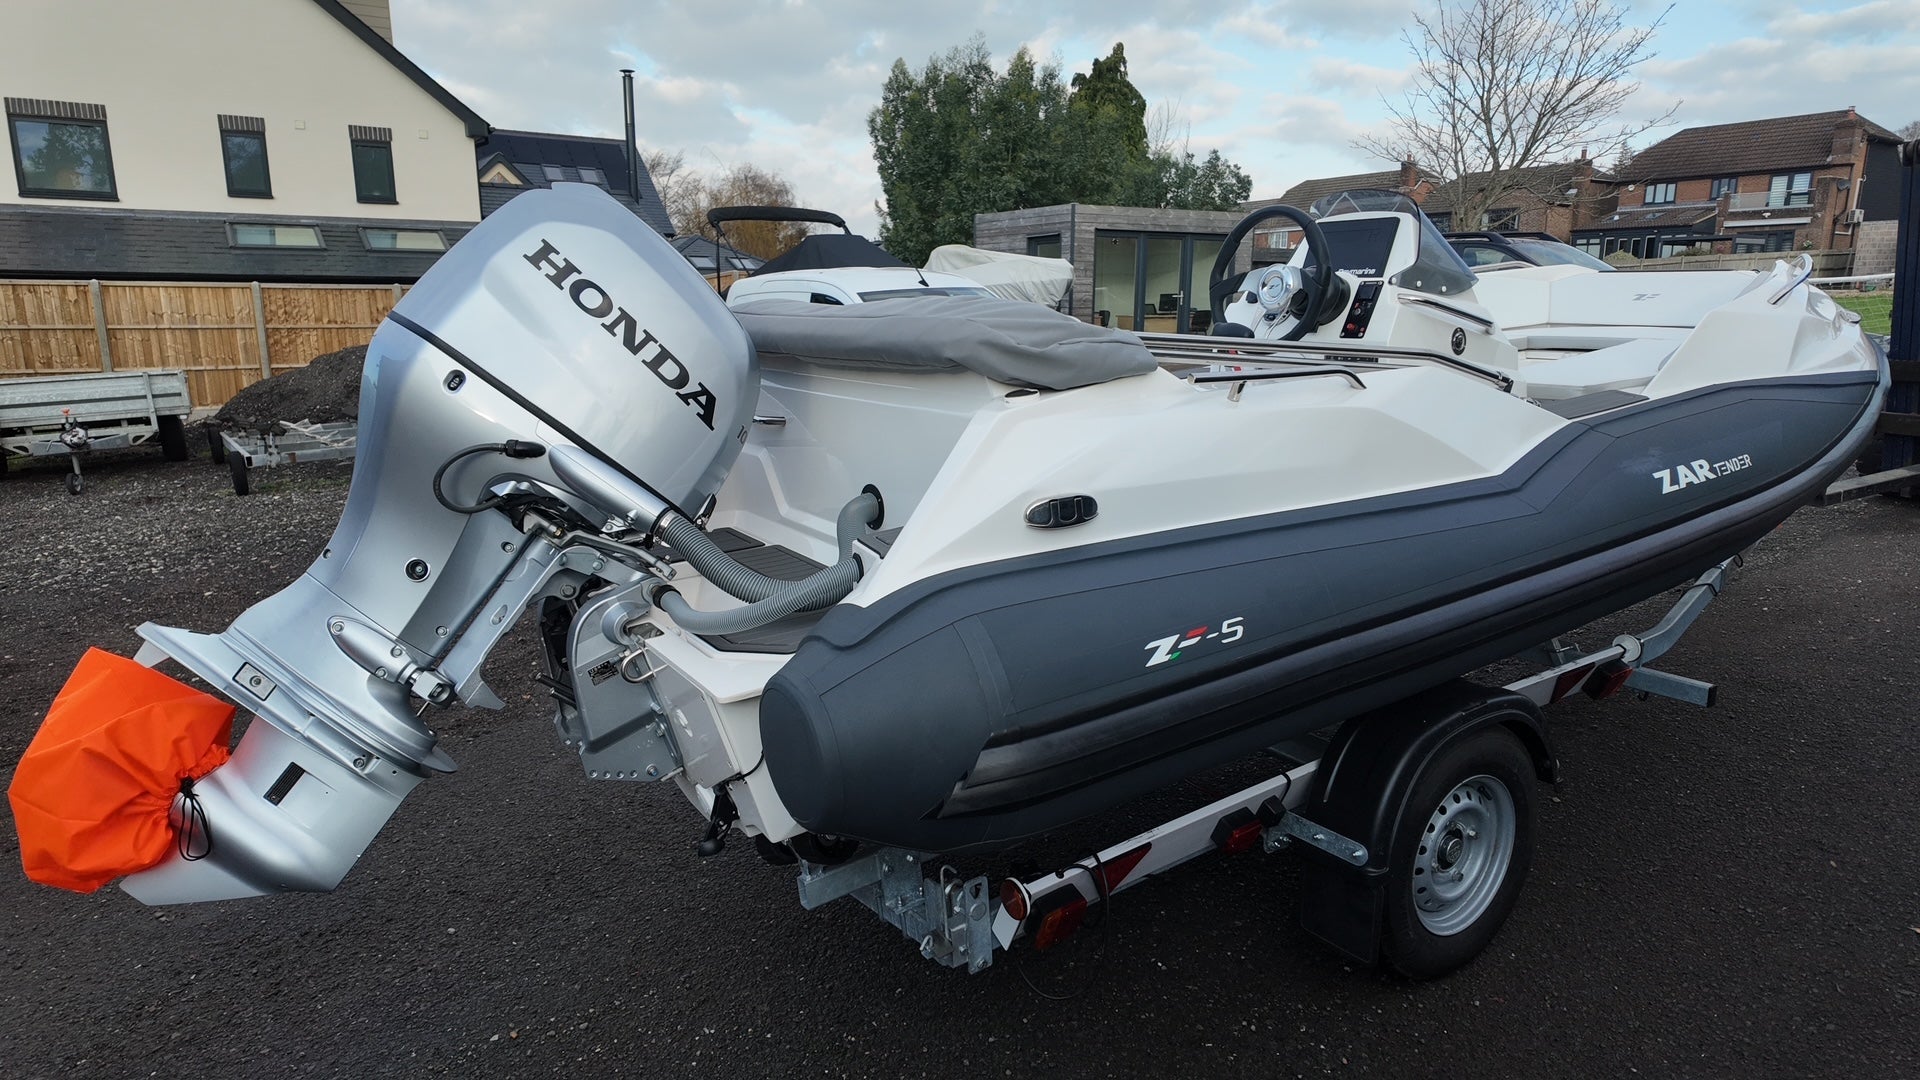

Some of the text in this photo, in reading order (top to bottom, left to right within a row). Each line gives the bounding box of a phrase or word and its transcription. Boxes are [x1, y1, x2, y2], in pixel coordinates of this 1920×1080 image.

[523, 238, 717, 431] HONDA
[1652, 454, 1752, 494] ZAR TENDER
